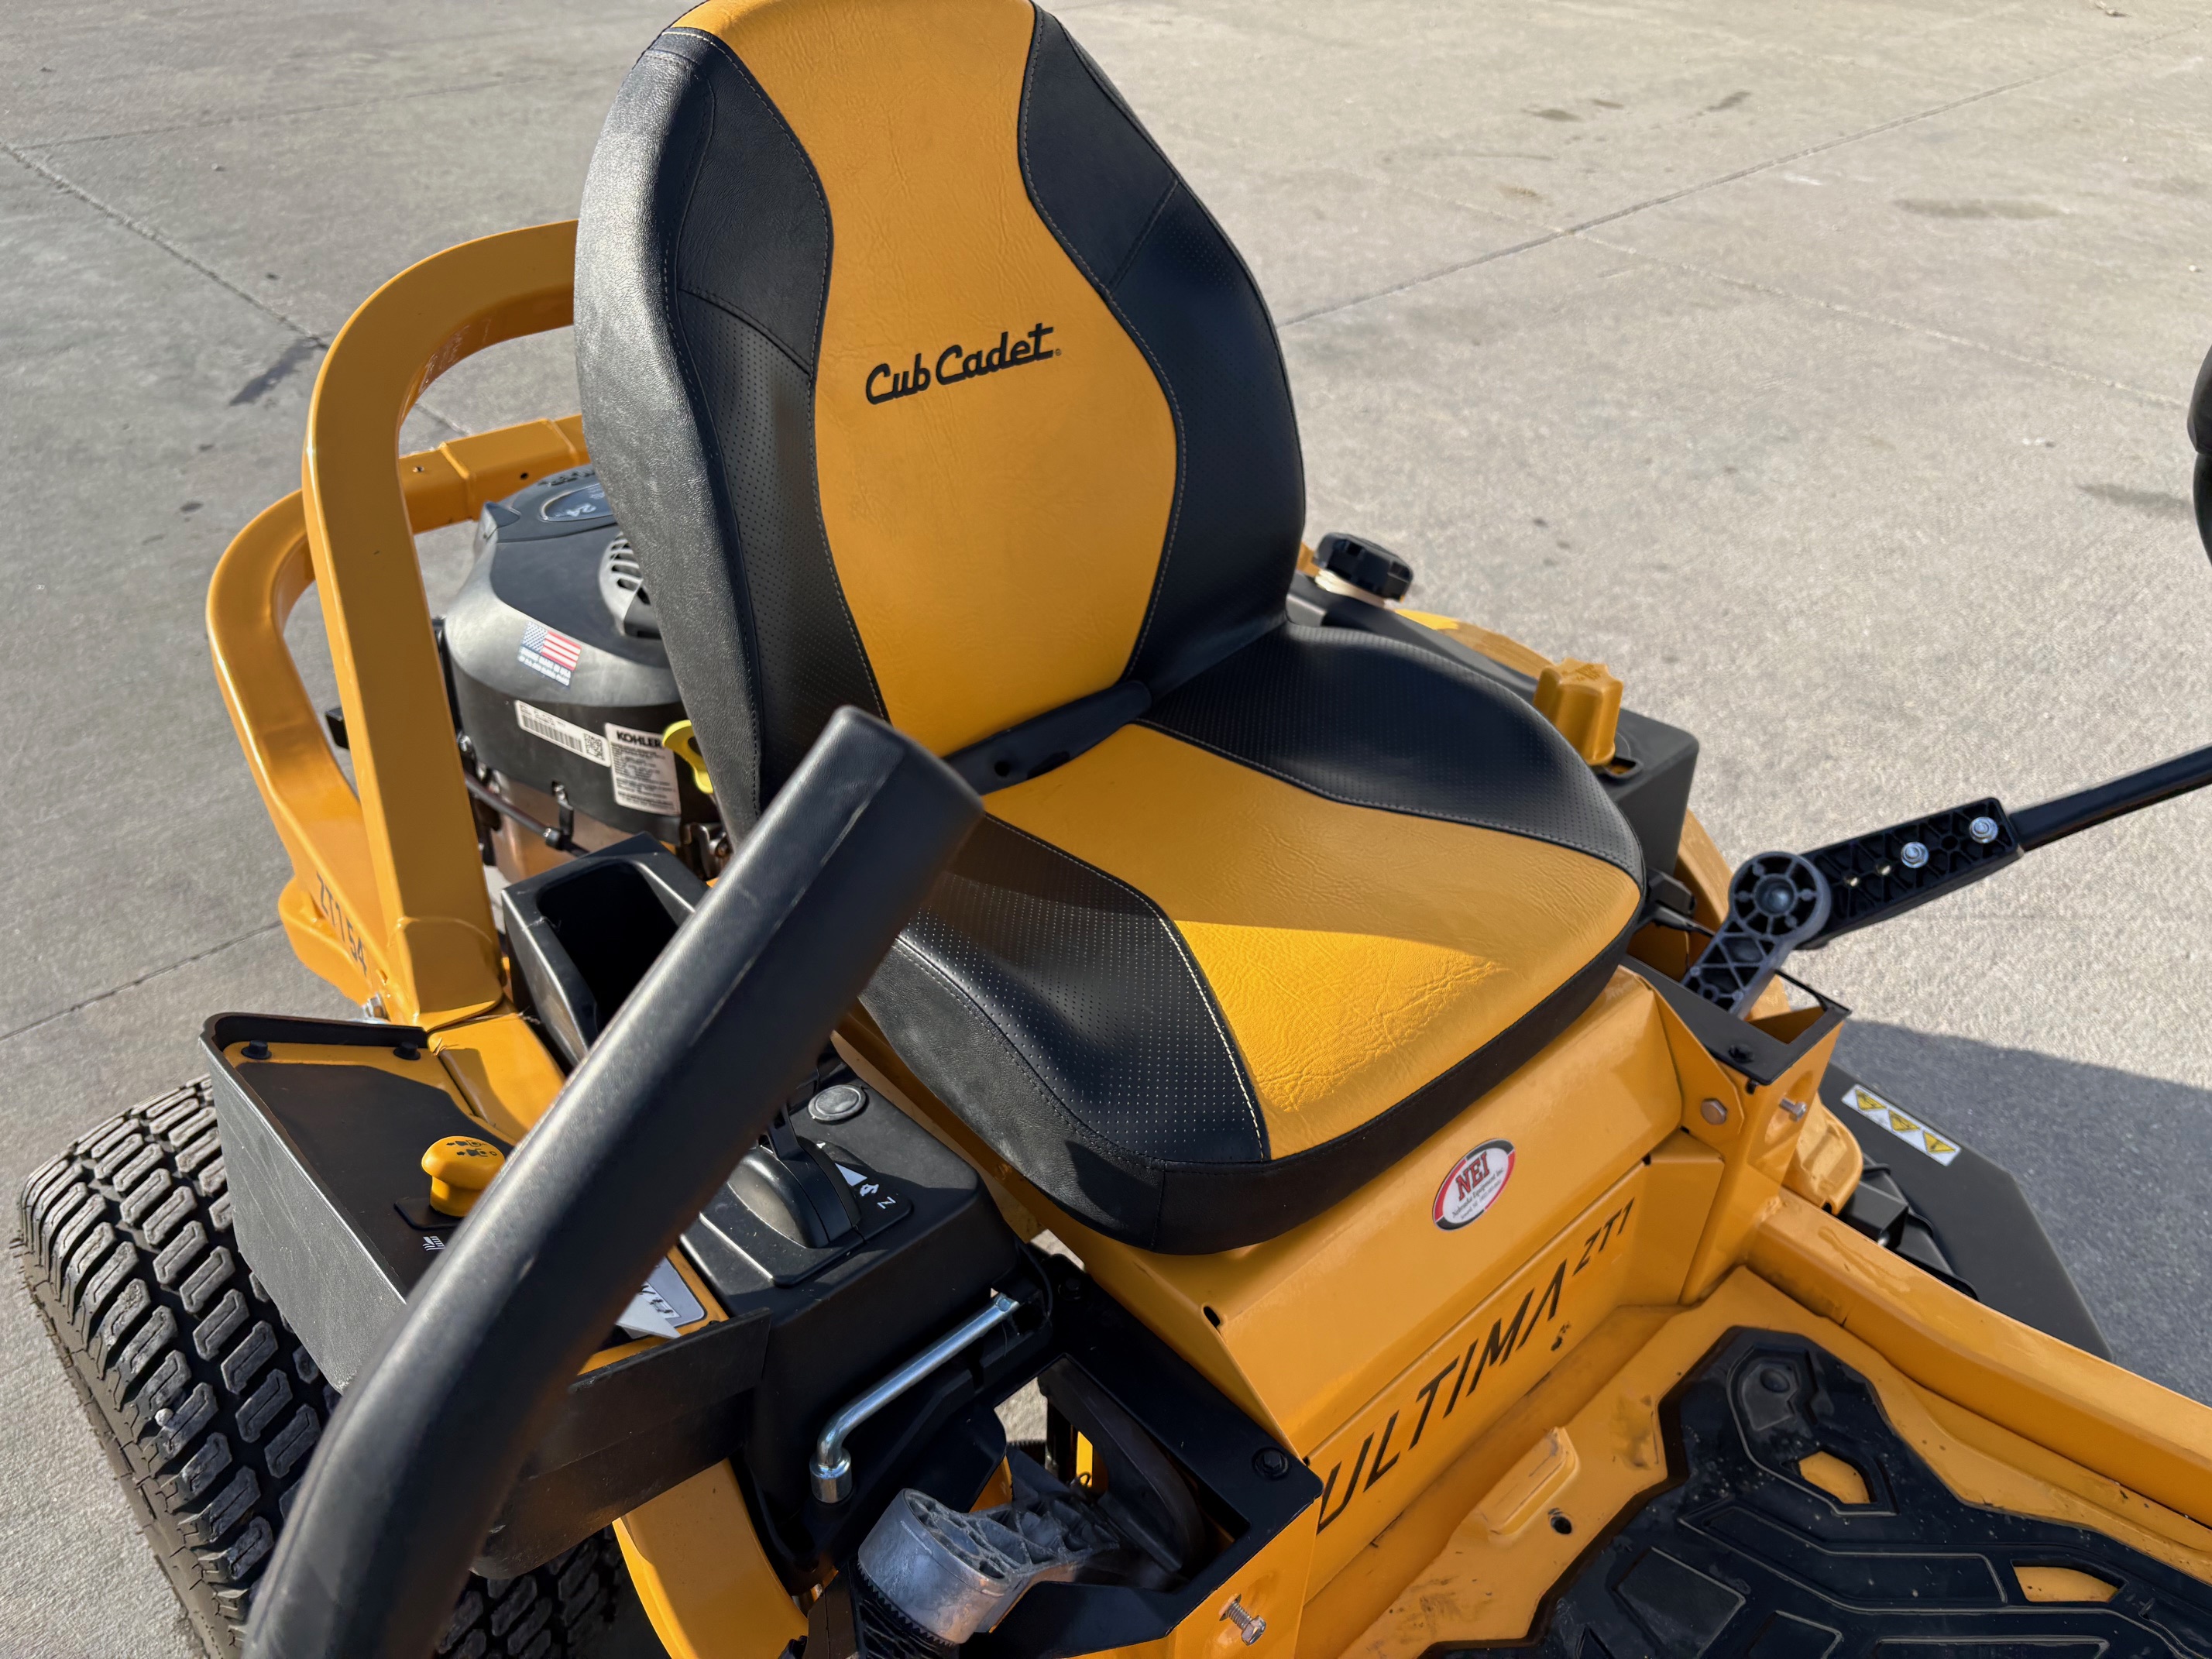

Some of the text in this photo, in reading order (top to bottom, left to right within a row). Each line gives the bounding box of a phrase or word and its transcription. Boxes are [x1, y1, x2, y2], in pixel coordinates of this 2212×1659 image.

[865, 322, 1054, 405] Cub Cadet
[617, 730, 664, 749] KOHLER
[1455, 1151, 1490, 1201] NEI
[1317, 1197, 1635, 1536] ULTIMA ZT1
